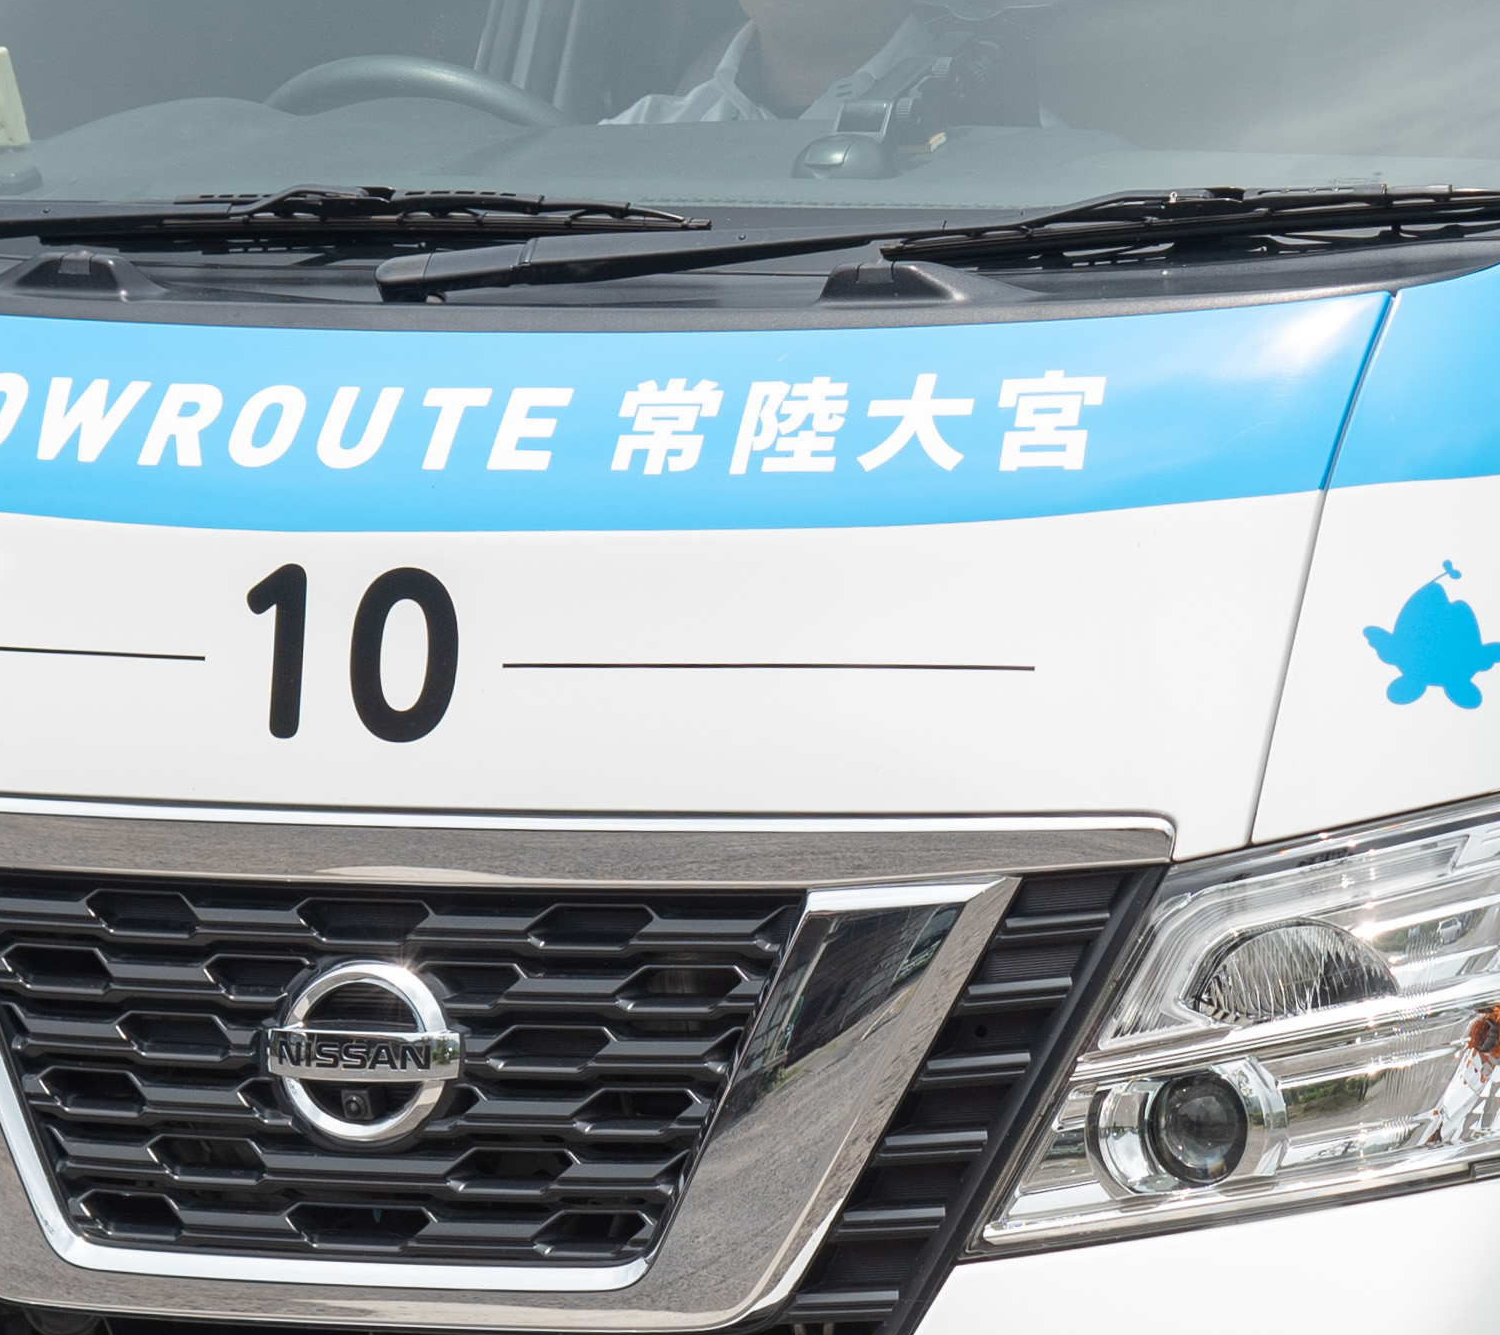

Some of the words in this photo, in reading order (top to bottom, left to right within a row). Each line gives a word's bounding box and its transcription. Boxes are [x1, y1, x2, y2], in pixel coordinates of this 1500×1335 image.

[610, 368, 1107, 476] 常陸大宮
[246, 562, 460, 744] 10
[277, 1038, 432, 1071] NISSAN
